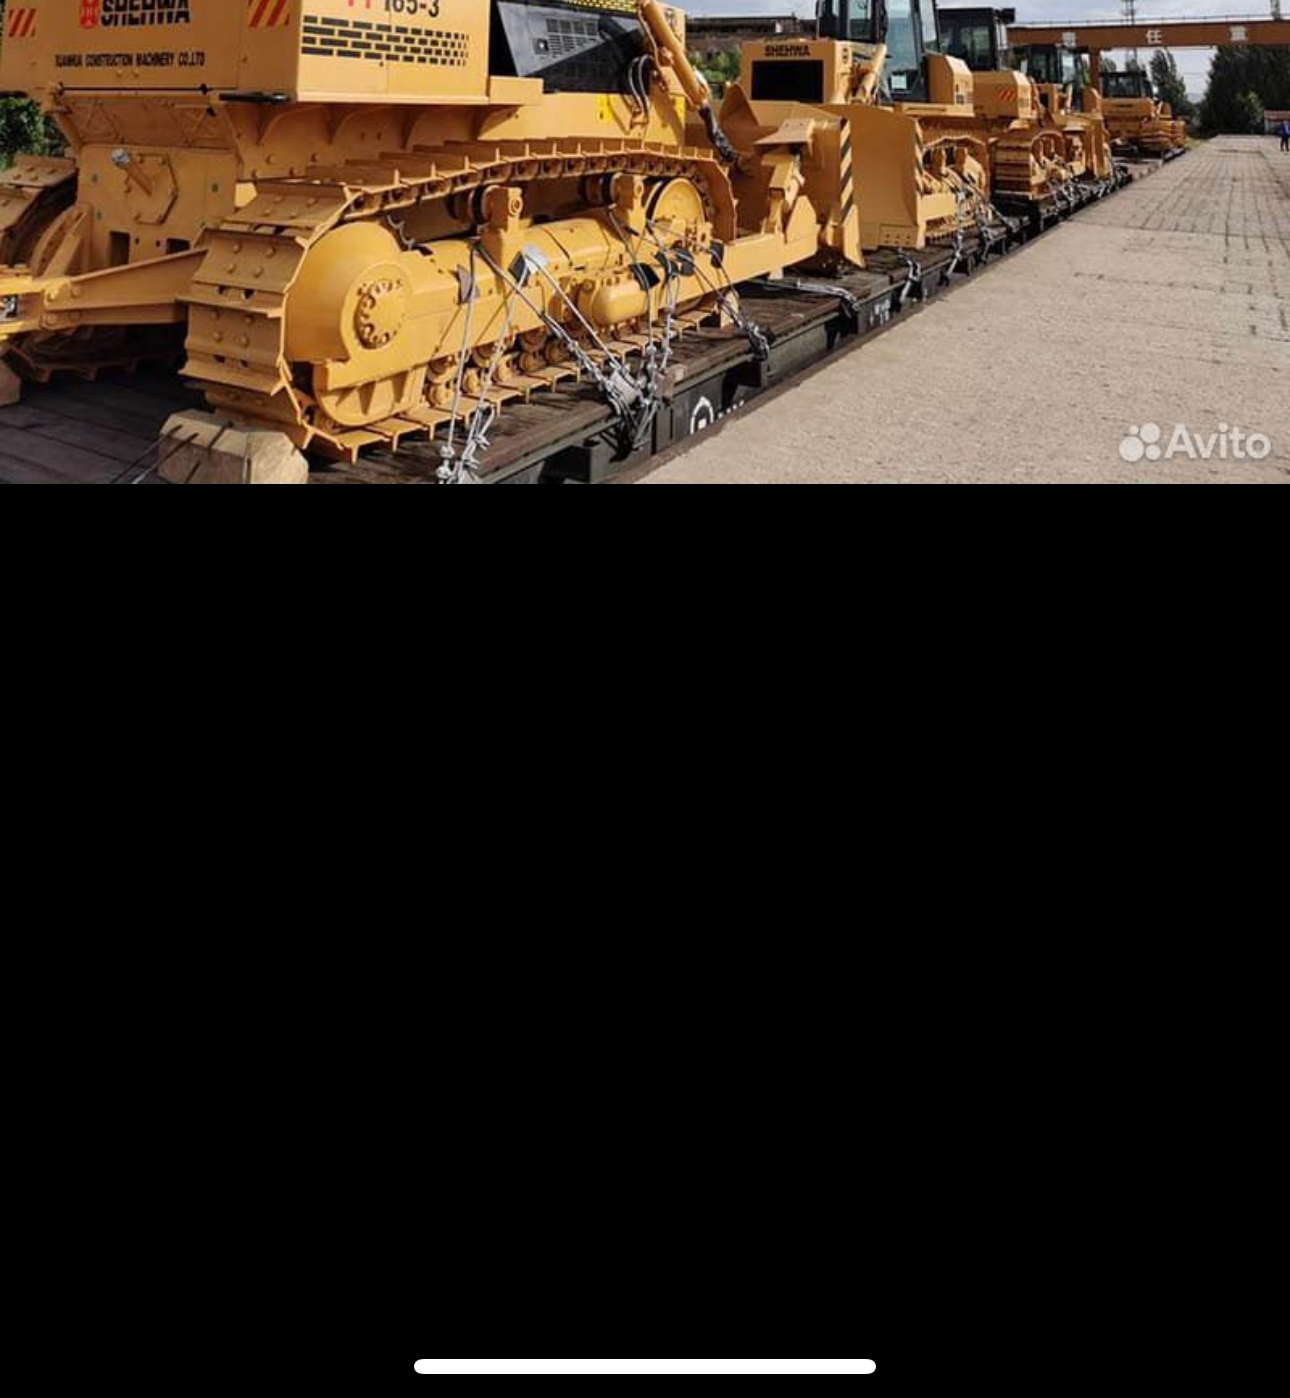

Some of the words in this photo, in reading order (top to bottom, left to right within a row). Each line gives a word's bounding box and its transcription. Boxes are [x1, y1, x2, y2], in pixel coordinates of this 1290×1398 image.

[764, 44, 811, 57] SHEHWA
[85, 52, 133, 67] CONSTRUCTION
[136, 51, 175, 67] MACHINERY
